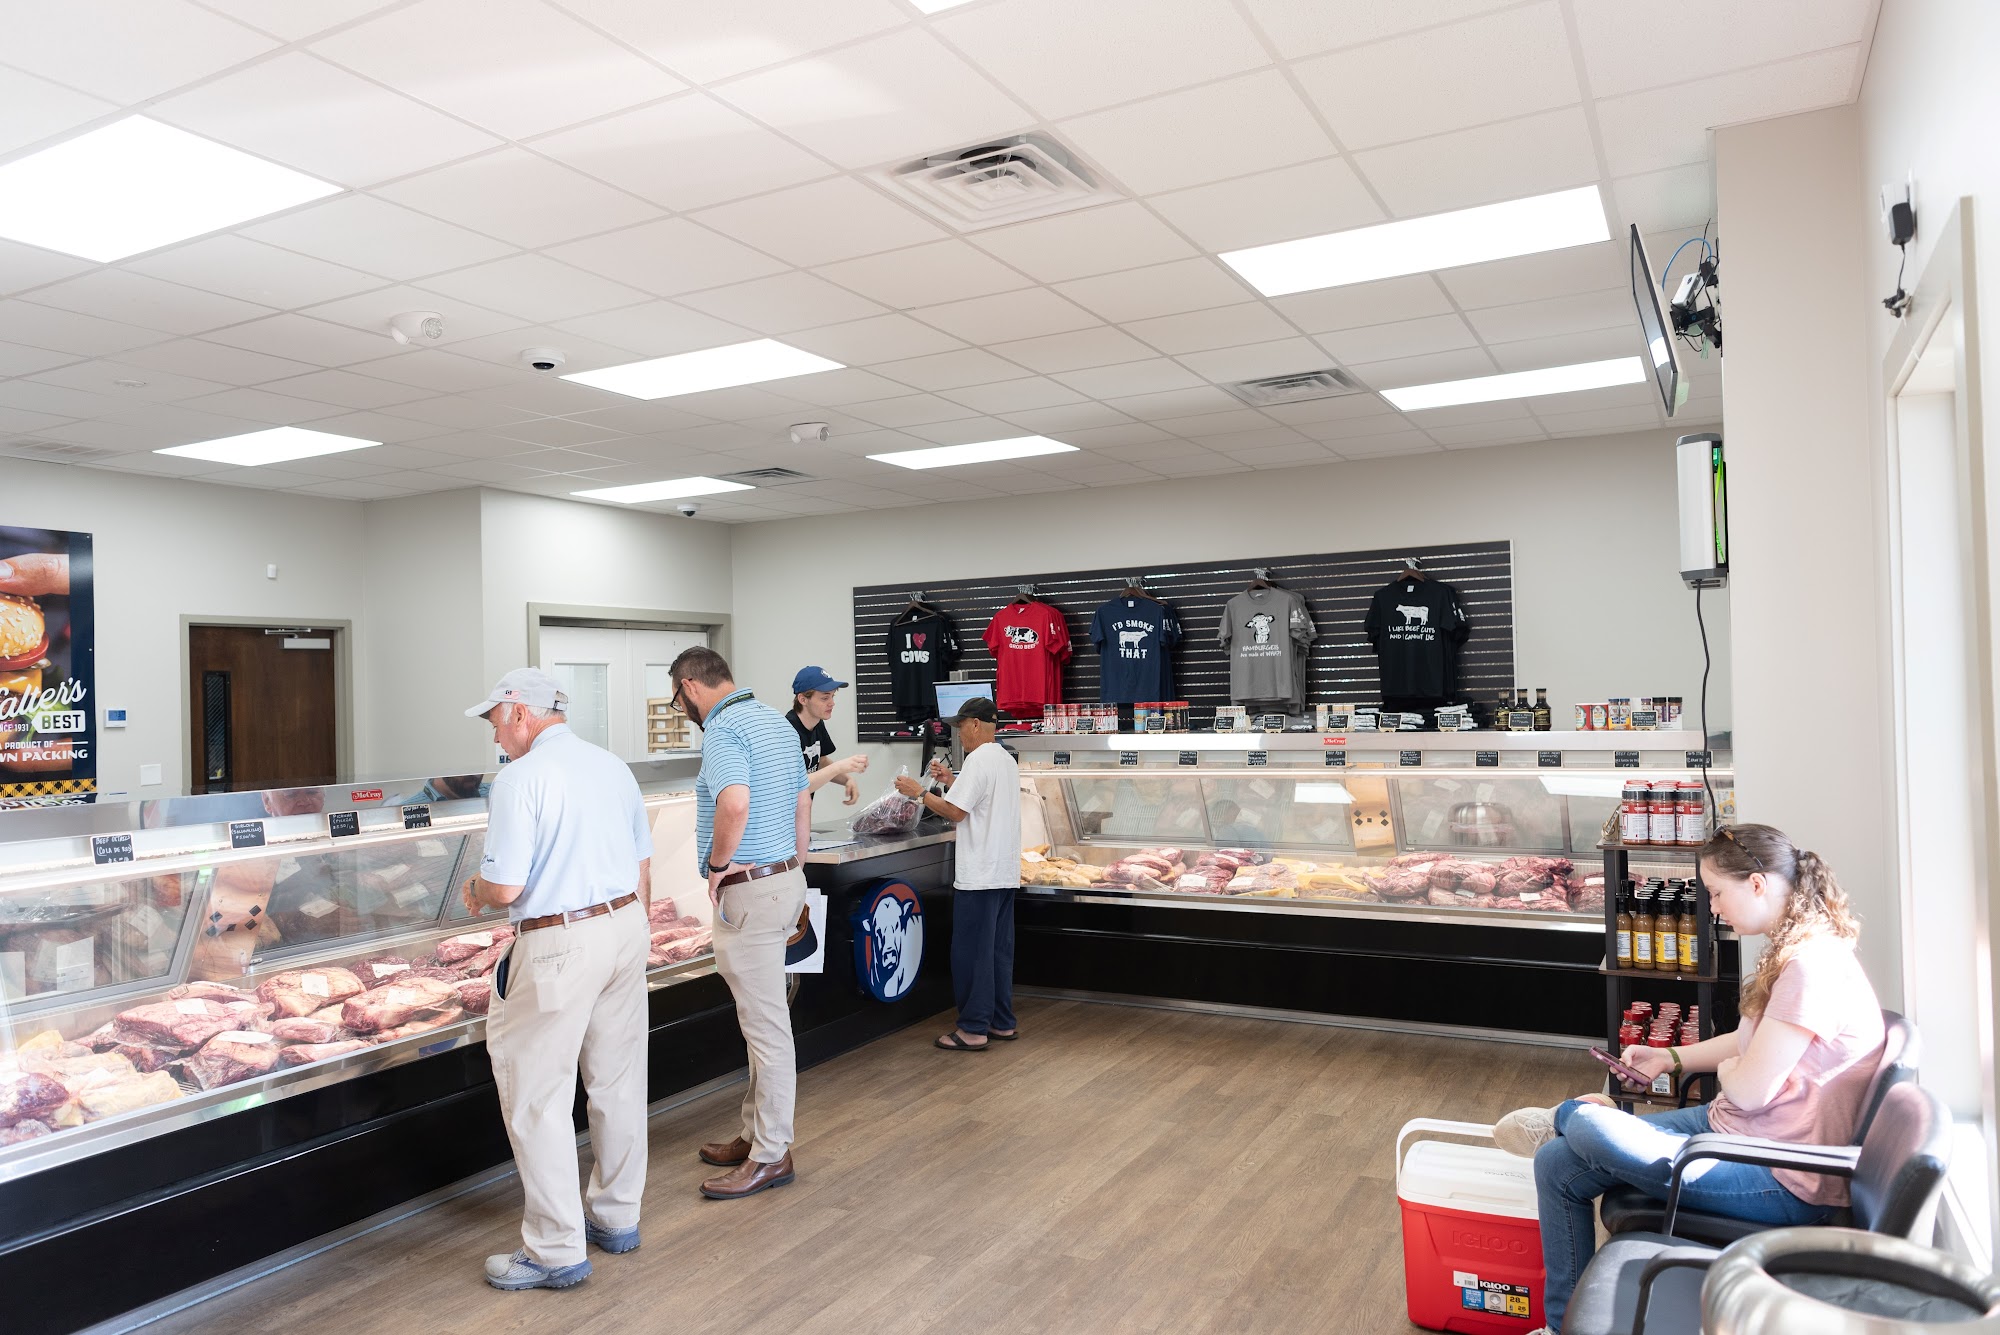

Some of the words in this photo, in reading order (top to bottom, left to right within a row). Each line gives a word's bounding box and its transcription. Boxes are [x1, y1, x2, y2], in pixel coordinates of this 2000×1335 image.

[1112, 621, 1124, 632] I'D
[1125, 619, 1155, 633] SMOKE
[1420, 626, 1436, 634] CUTS
[905, 633, 912, 649] I
[1119, 647, 1148, 659] THAT
[15, 723, 29, 732] 1931
[41, 714, 82, 730] BEST
[5, 741, 41, 750] PRODUCT
[44, 740, 54, 748] OF
[22, 749, 89, 762] PACKING
[353, 790, 382, 800] McCray
[95, 836, 110, 845] BEEF
[1453, 1231, 1528, 1254] IGLOO
[1479, 1280, 1511, 1291] IGLOO
[1509, 1296, 1521, 1304] 28
